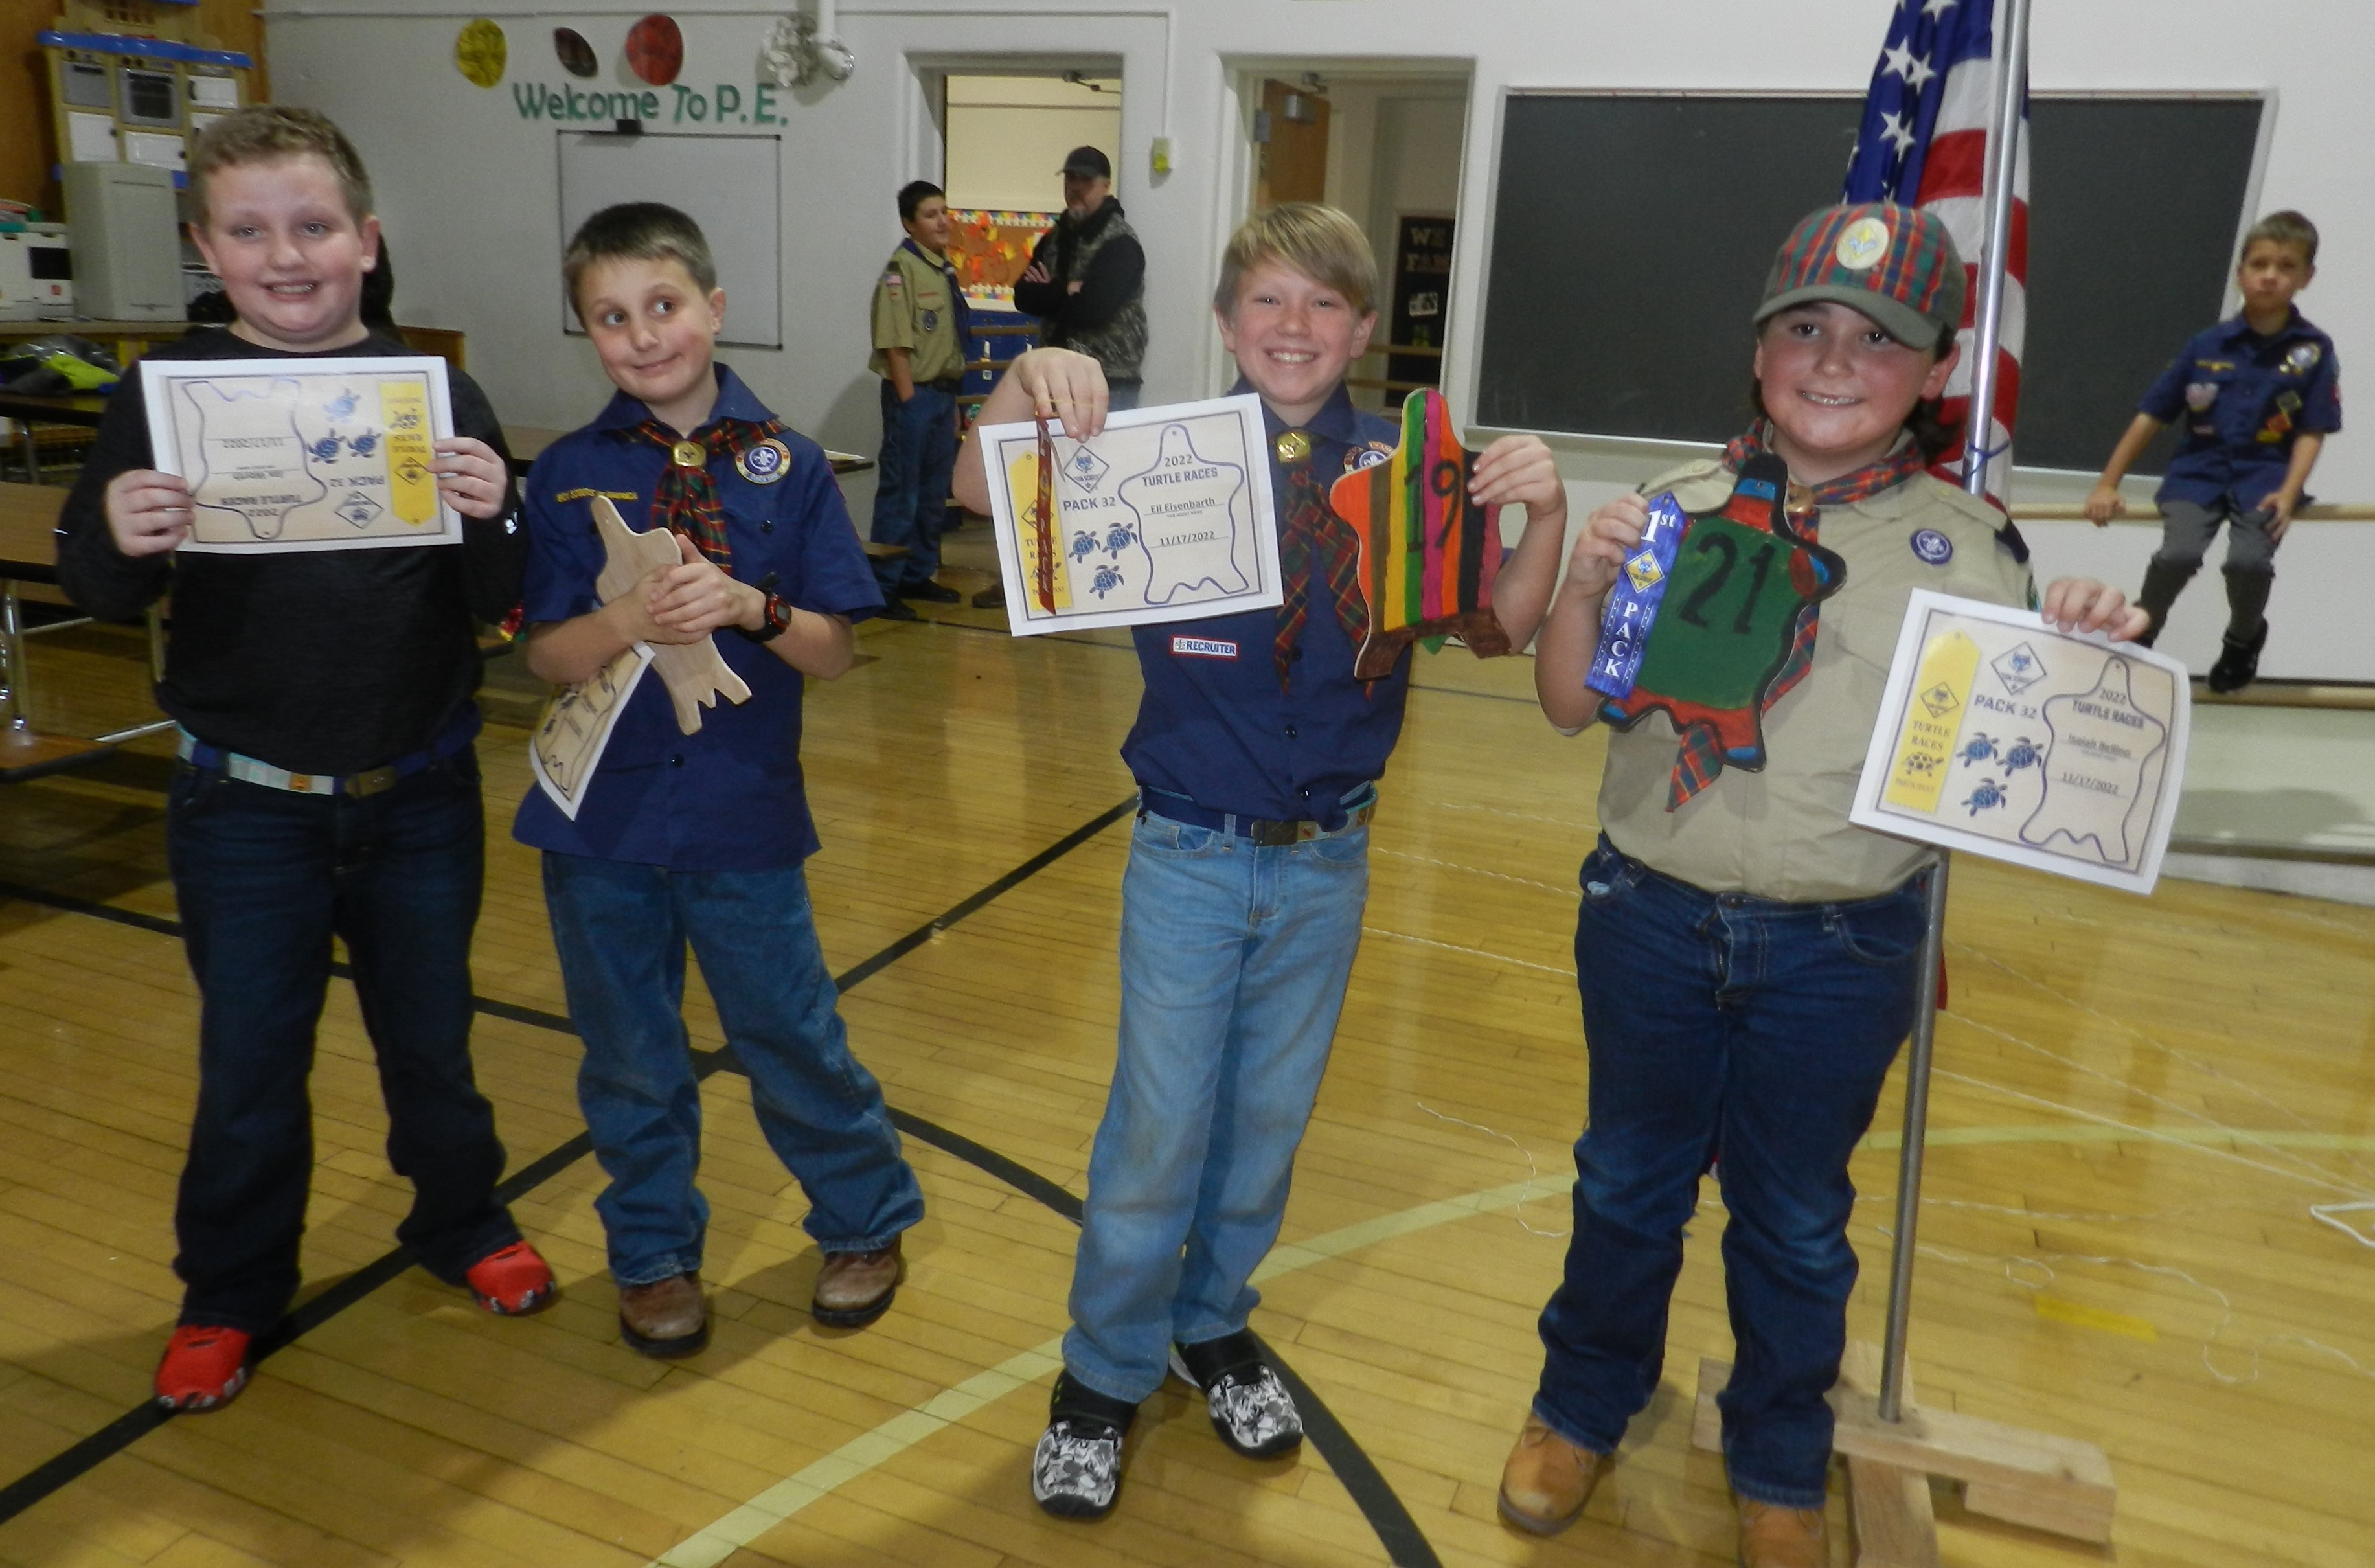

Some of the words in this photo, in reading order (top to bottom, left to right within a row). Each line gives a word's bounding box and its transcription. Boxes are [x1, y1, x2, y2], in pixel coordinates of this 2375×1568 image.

[513, 82, 659, 120] Welcome
[671, 84, 707, 123] To
[716, 83, 789, 126] P.E.
[1165, 454, 1192, 467] 2022
[330, 478, 344, 487] 32
[348, 475, 385, 486] PACK
[1142, 472, 1181, 486] TURTLE
[1184, 467, 1218, 482] RACES
[247, 508, 280, 517] 2022
[1063, 497, 1098, 512] PACK
[1102, 497, 1116, 507] 32
[1150, 504, 1163, 514] Eli
[1165, 497, 1215, 512] Eisenbarth
[1404, 460, 1463, 553] 19
[1641, 510, 1676, 543] 1st
[1159, 530, 1215, 546] 11/17/2022
[1679, 531, 1777, 635] 21
[1186, 641, 1236, 655] RECRUITER
[1604, 601, 1639, 679] PACK
[2099, 689, 2127, 705] 2022
[1975, 694, 2017, 715] PACK
[2020, 705, 2037, 719] 32
[2073, 699, 2111, 720] TURTLE
[1913, 720, 1951, 737] TURTLE
[1911, 736, 1944, 750] RACES
[2062, 772, 2119, 795] 11/17/2022
